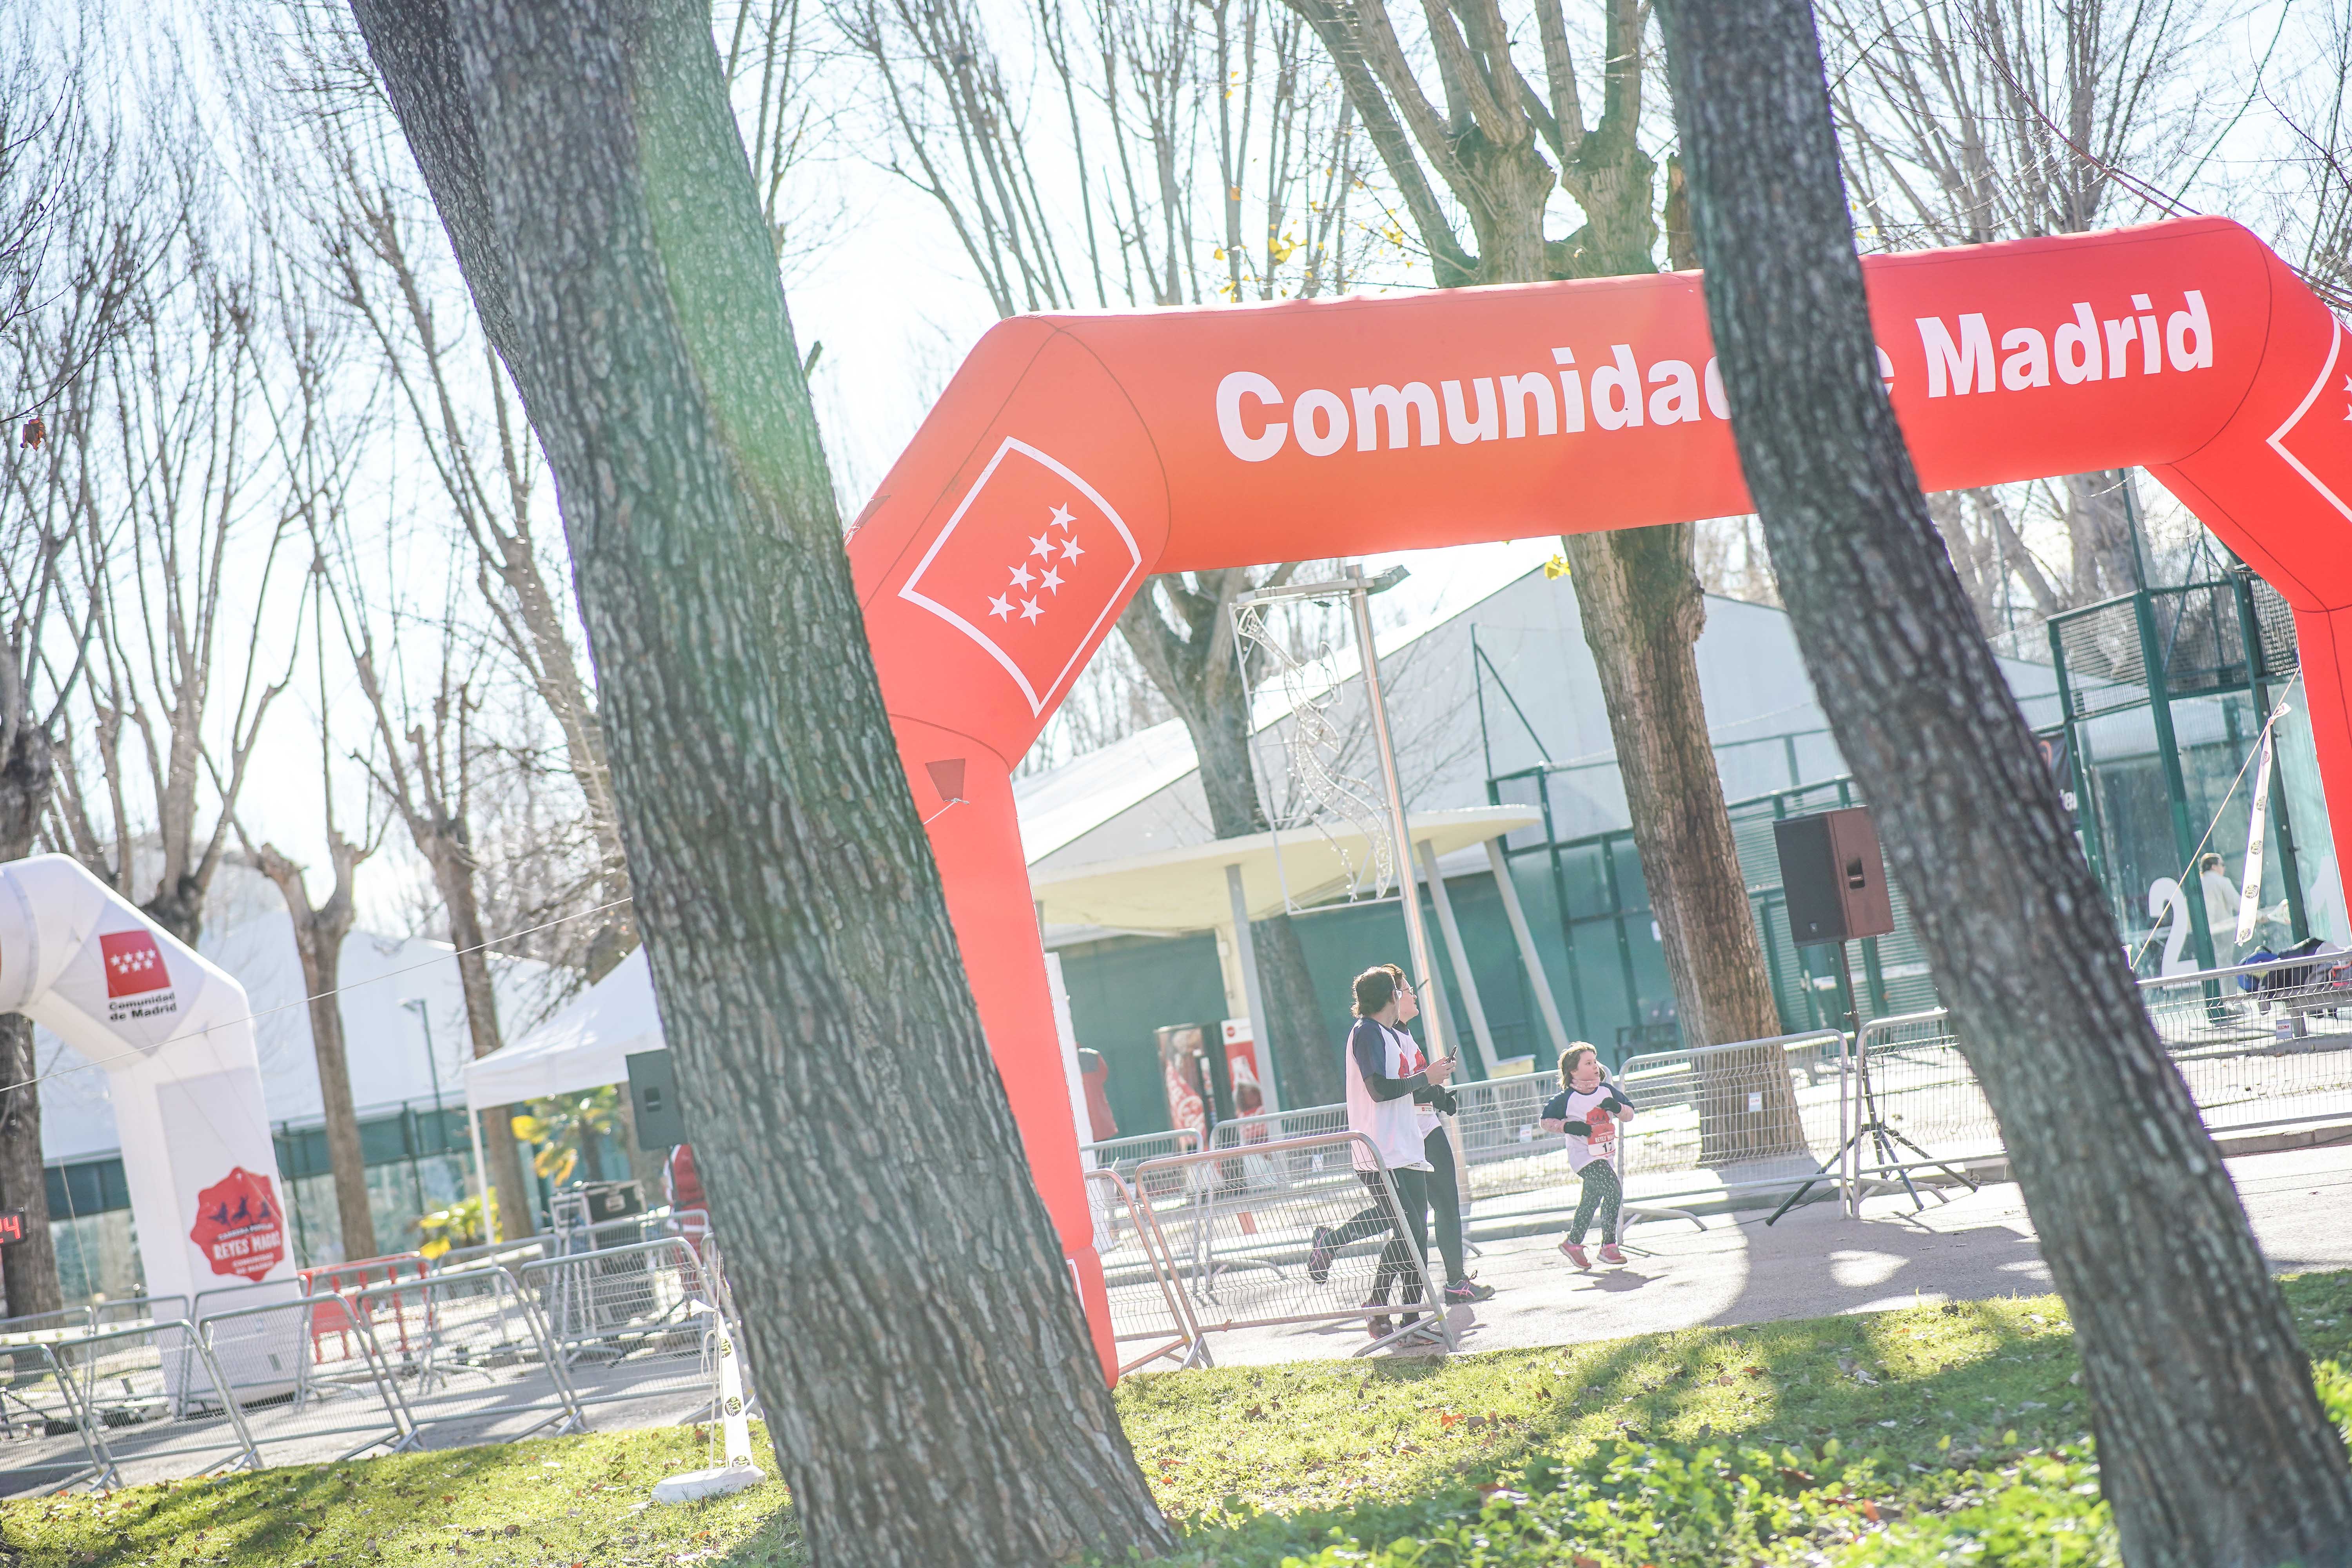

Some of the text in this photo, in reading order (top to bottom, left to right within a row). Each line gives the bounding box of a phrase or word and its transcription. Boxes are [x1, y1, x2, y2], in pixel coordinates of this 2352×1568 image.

[1915, 290, 2213, 398] Madrid
[2149, 877, 2203, 990] 2
[109, 991, 175, 1010] Comunidad
[110, 1002, 177, 1021] de Madrid
[1602, 1142, 1612, 1152] 17
[213, 1238, 250, 1260] REYES
[726, 1401, 735, 1417] Sport
[731, 1396, 741, 1412] Life
